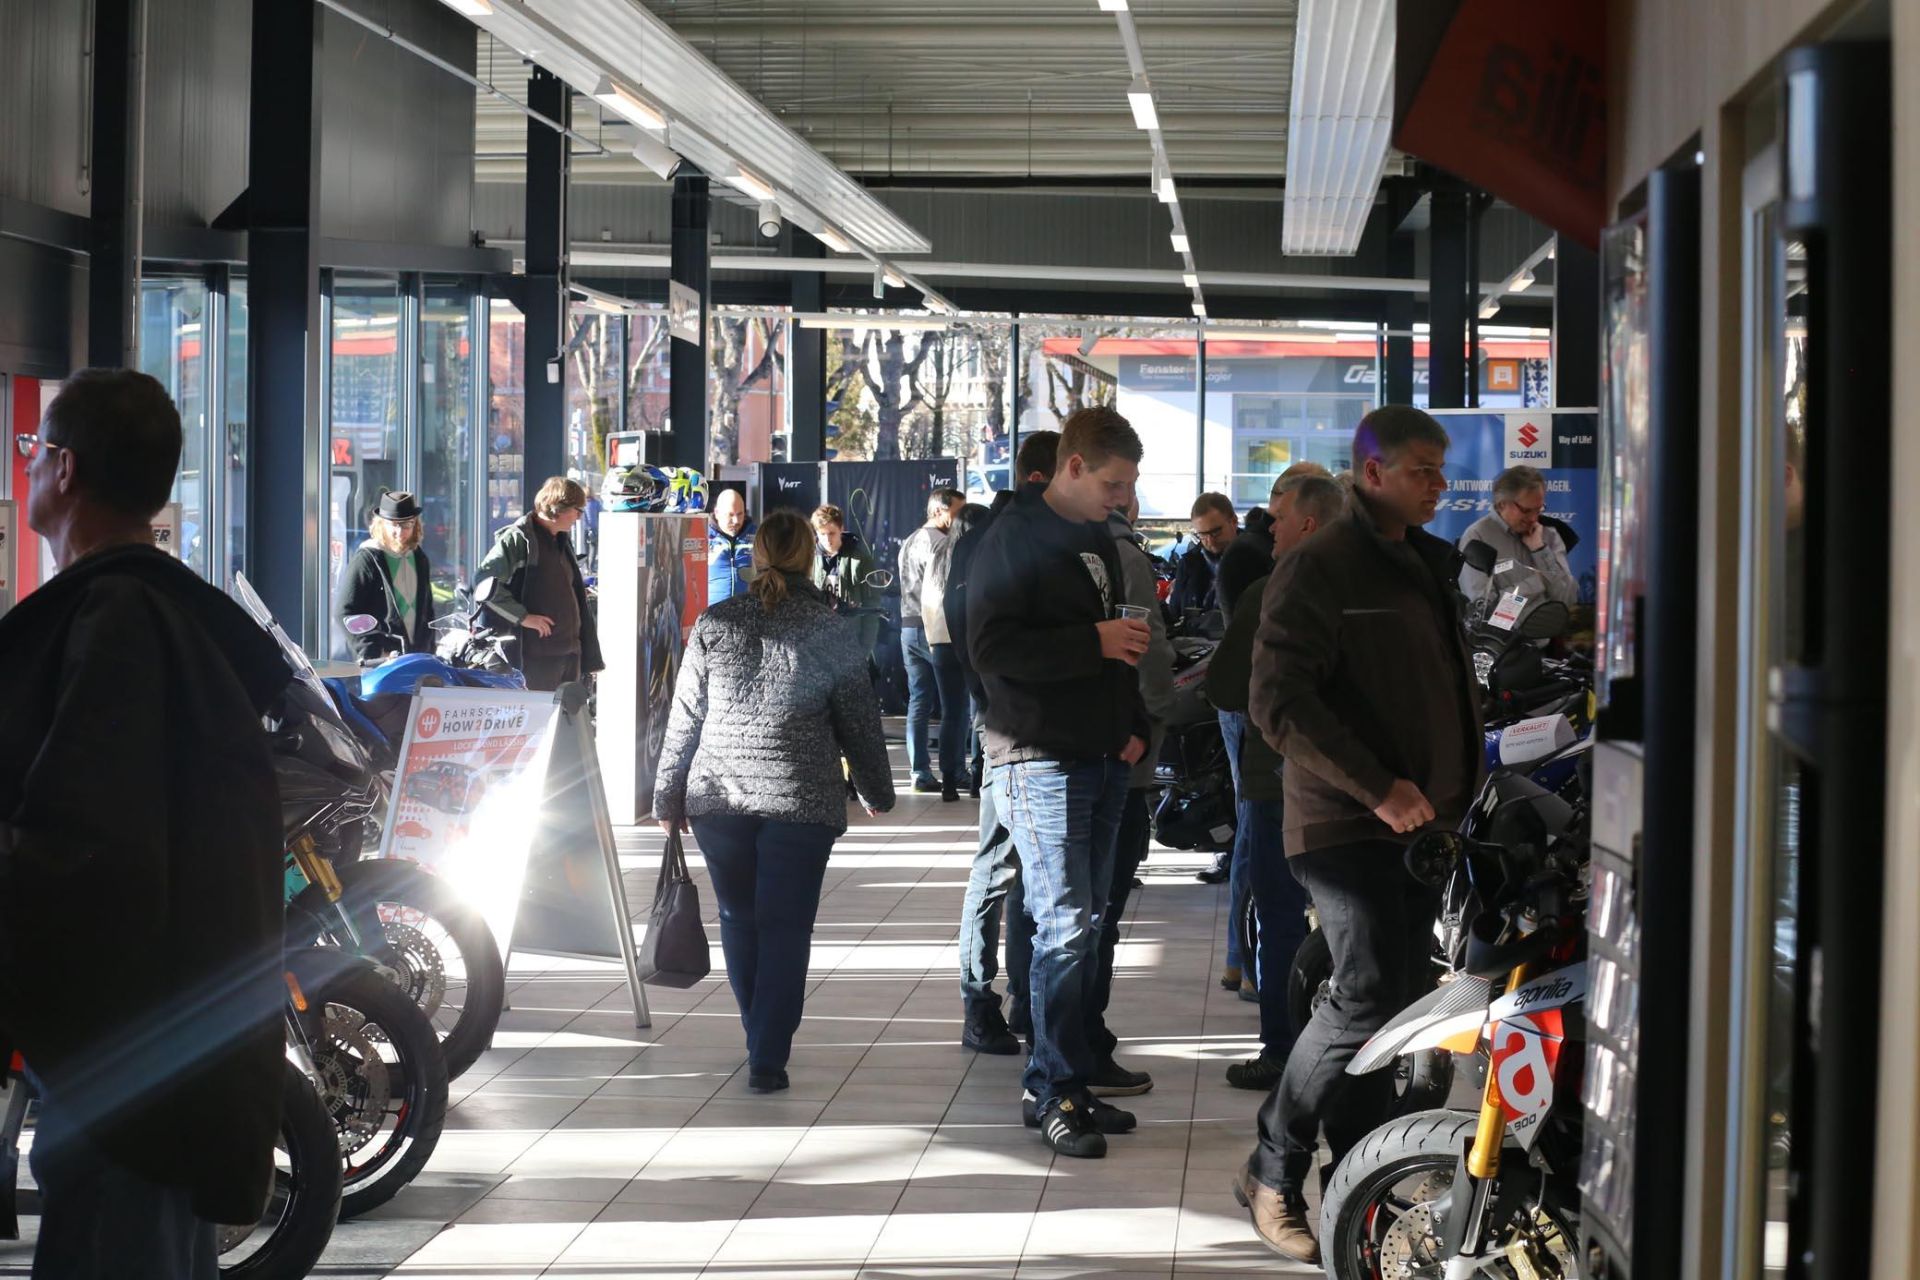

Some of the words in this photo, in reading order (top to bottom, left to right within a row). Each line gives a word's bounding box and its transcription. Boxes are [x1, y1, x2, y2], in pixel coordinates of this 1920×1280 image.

[1510, 451, 1547, 459] SUZUKI
[784, 480, 801, 488] MT
[935, 477, 951, 486] MT
[1514, 977, 1573, 1009] aprilia
[1514, 1113, 1537, 1131] 900
